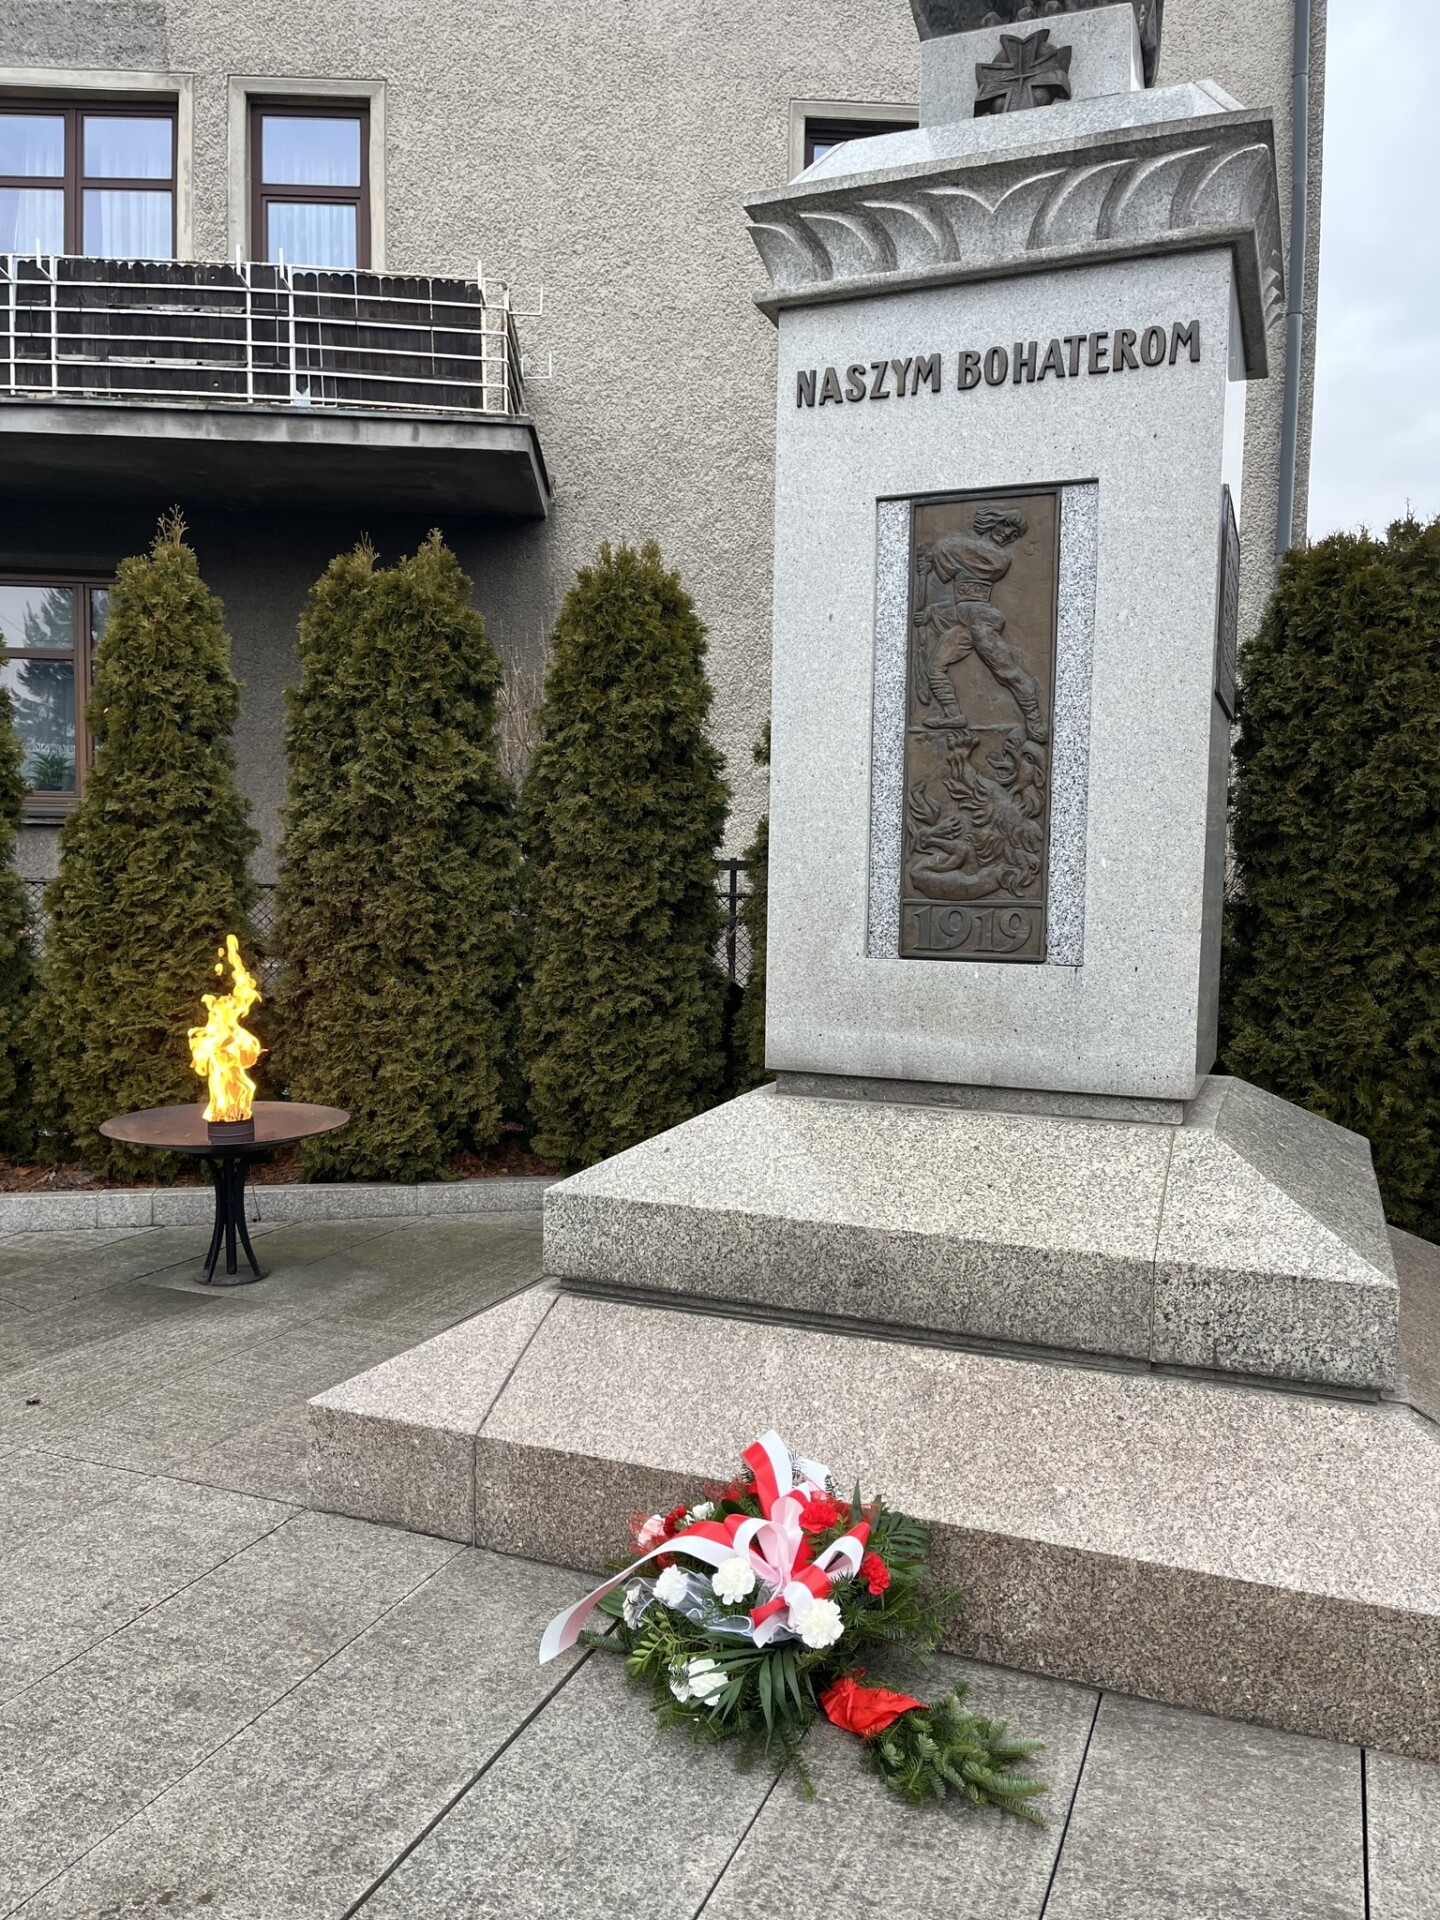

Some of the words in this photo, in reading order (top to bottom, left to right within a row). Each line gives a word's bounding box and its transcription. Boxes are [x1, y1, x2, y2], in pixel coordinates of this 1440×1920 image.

[796, 353, 942, 408] NASZYM
[957, 319, 1201, 390] BOHATEROM
[912, 905, 1033, 953] 1919
